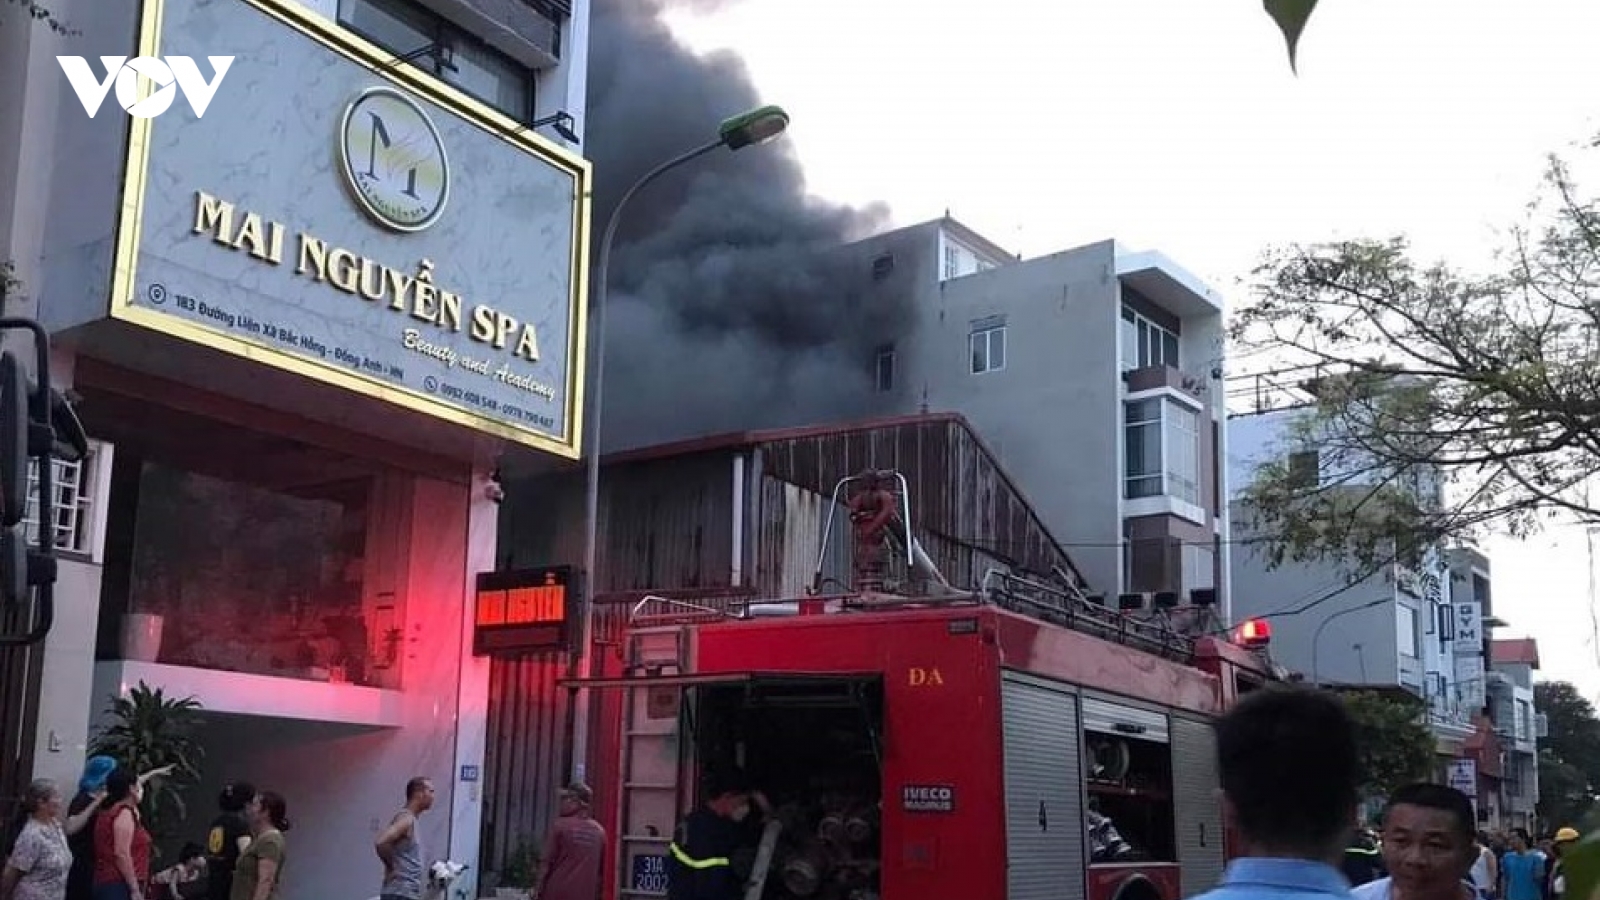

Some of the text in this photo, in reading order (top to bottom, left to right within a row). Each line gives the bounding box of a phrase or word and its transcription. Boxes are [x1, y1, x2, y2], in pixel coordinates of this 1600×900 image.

[192, 190, 540, 361] MAI NGUYỄN SPA
[174, 294, 196, 311] 183
[198, 301, 235, 328] Đường
[402, 328, 556, 402] Beauty and Academy
[1459, 605, 1475, 639] GYM
[904, 787, 951, 799] IVECO
[1038, 800, 1047, 831] 4
